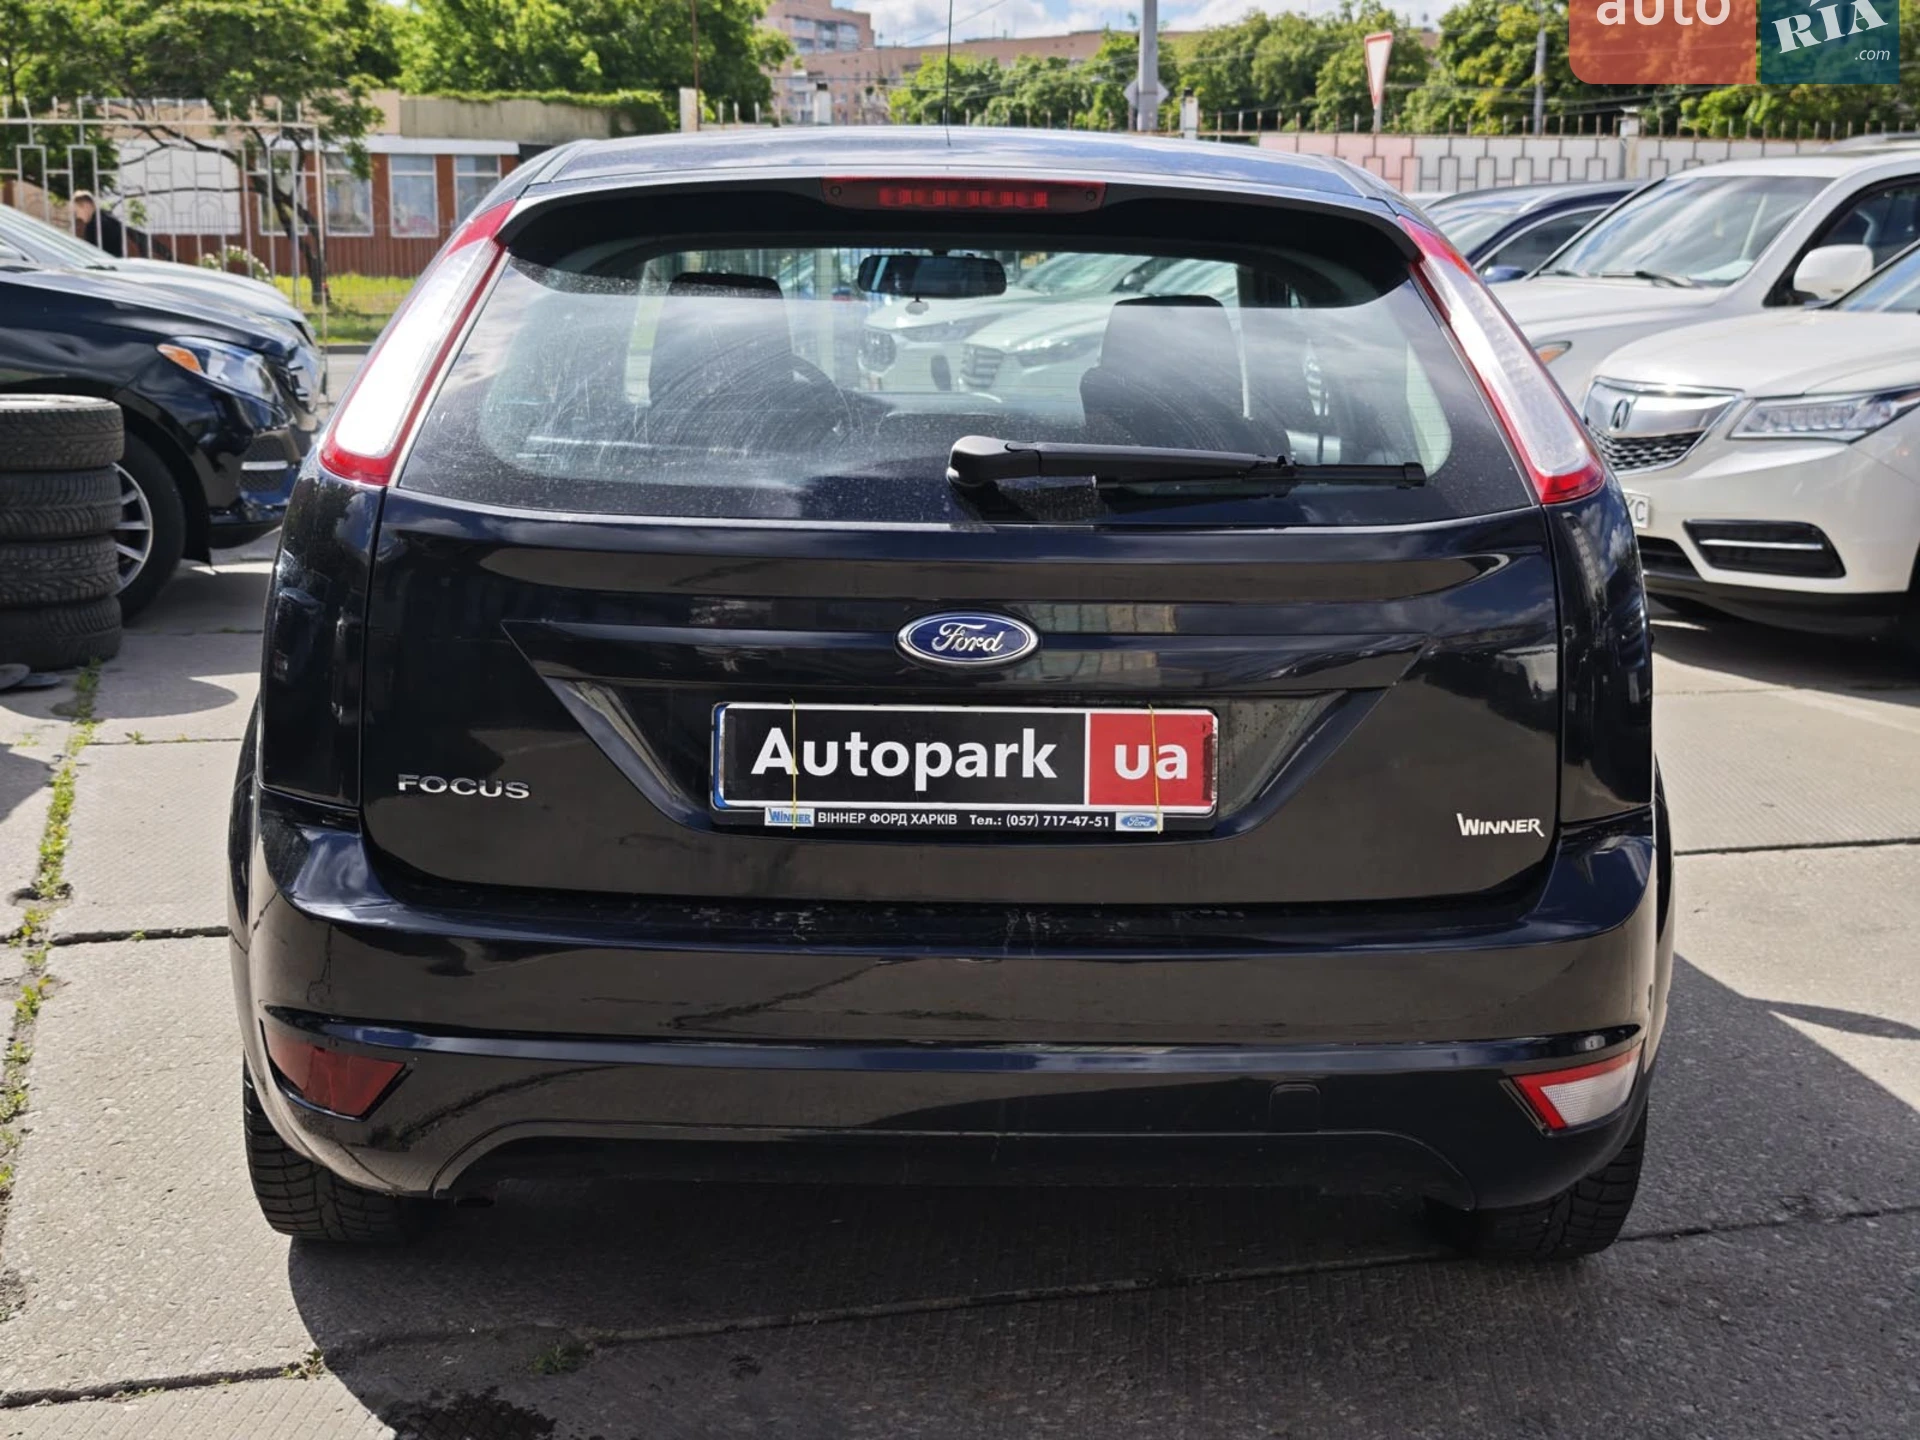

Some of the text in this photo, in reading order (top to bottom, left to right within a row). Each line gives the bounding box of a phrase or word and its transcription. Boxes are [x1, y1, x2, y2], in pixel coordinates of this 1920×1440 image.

[931, 622, 1005, 652] Ford
[751, 727, 1189, 792] Autopark ua
[398, 774, 530, 799] FOCUS
[818, 811, 1110, 828] ВІННЕР ФОРД ХАРКІВ Тел.: (057) 717-47-51
[1126, 815, 1152, 828] Ford
